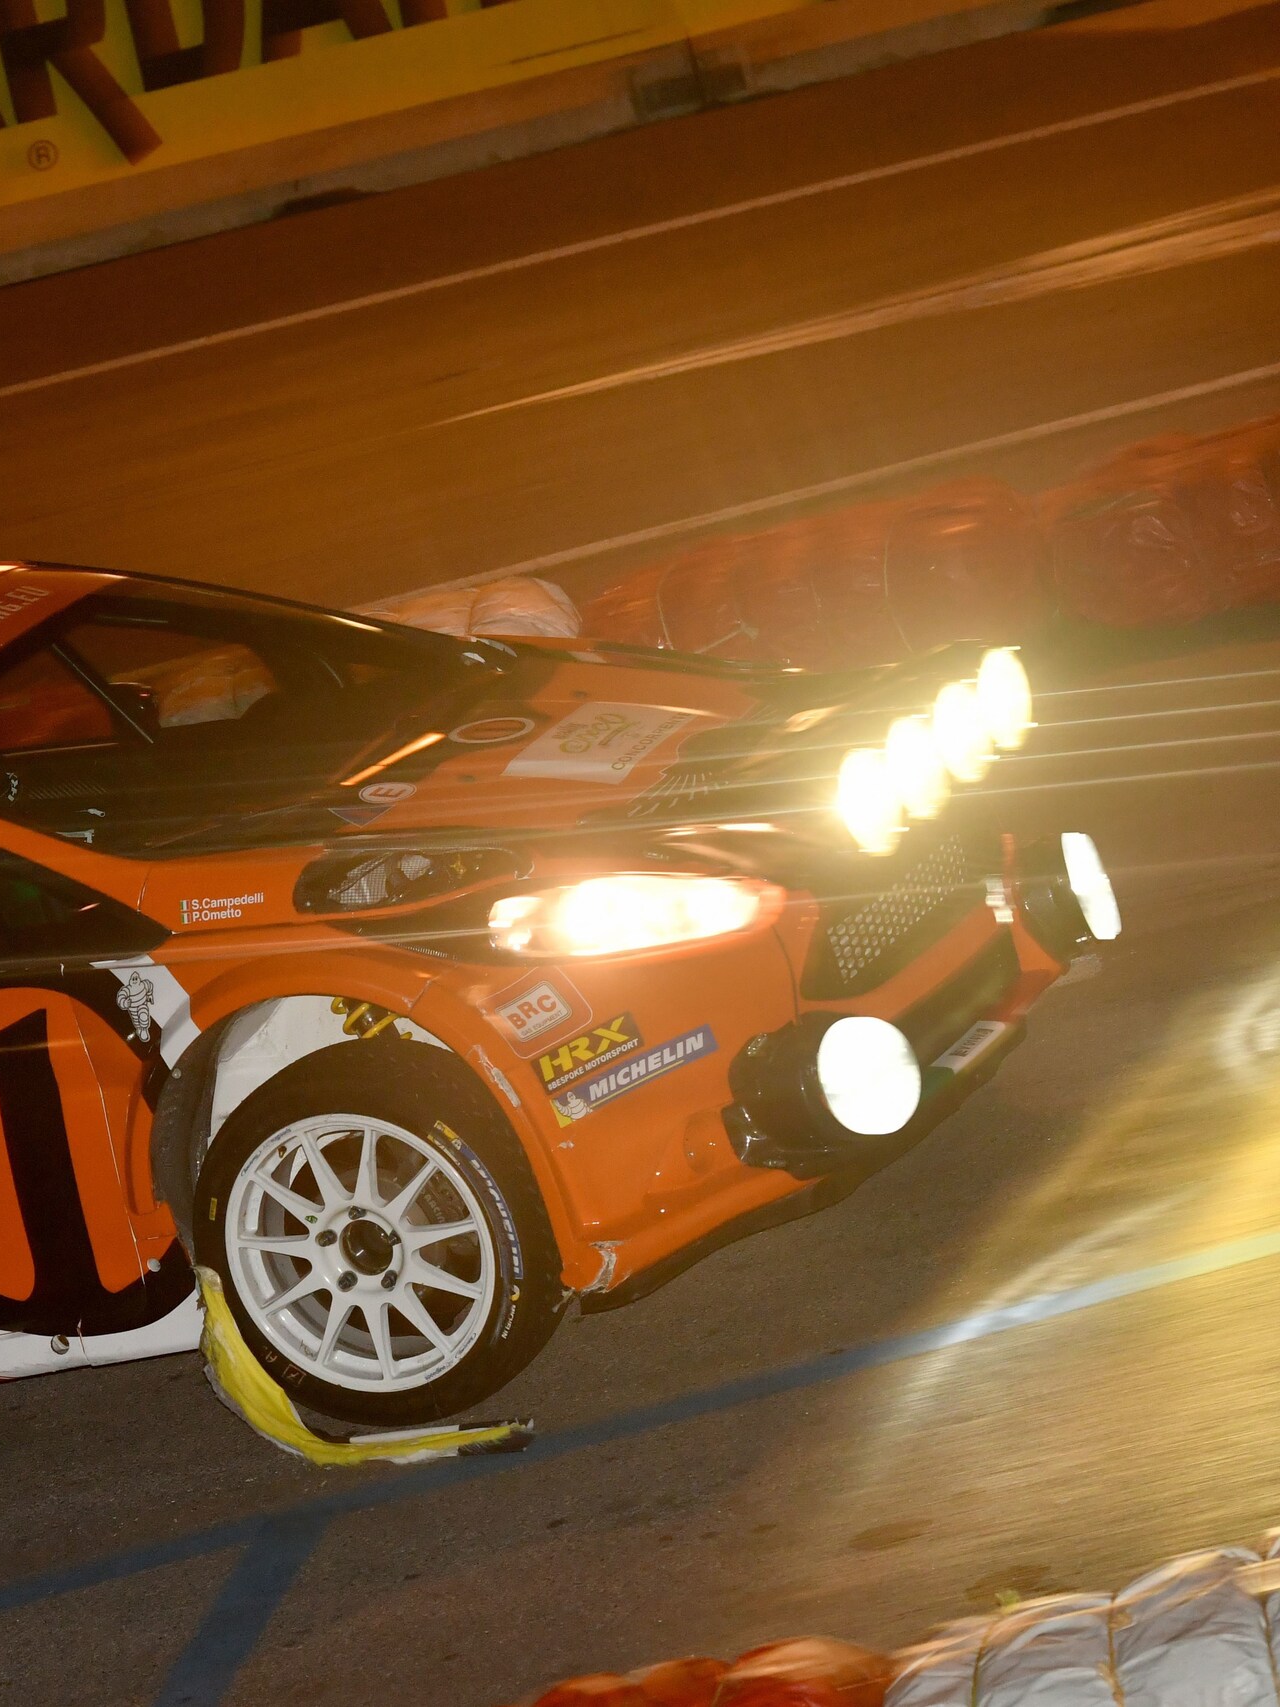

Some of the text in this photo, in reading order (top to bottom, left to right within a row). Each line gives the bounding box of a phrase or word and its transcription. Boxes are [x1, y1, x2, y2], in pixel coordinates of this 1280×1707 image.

[191, 892, 264, 910] S.Campedelli
[192, 908, 242, 922] P.Ometto
[506, 994, 557, 1029] BRC
[538, 1016, 630, 1081] HRX
[584, 1038, 639, 1071] MOTORSPORT
[589, 1032, 704, 1101] MICHELIN
